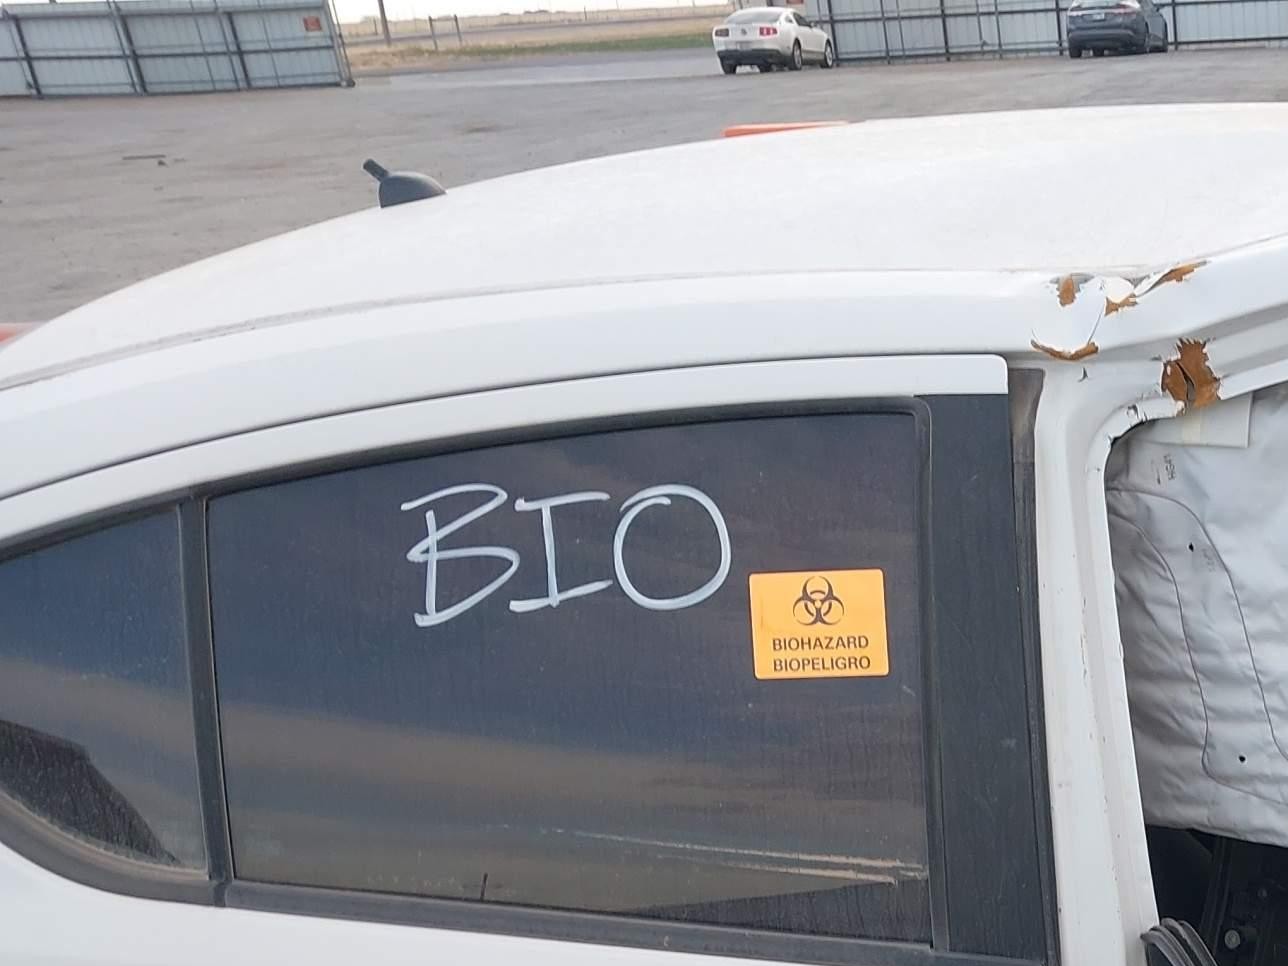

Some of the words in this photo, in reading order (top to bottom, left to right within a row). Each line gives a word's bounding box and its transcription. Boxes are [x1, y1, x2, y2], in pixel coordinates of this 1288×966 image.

[401, 483, 732, 628] BIO
[772, 635, 869, 651] BIOHAZARD
[773, 656, 871, 672] BIOPELIGRO
